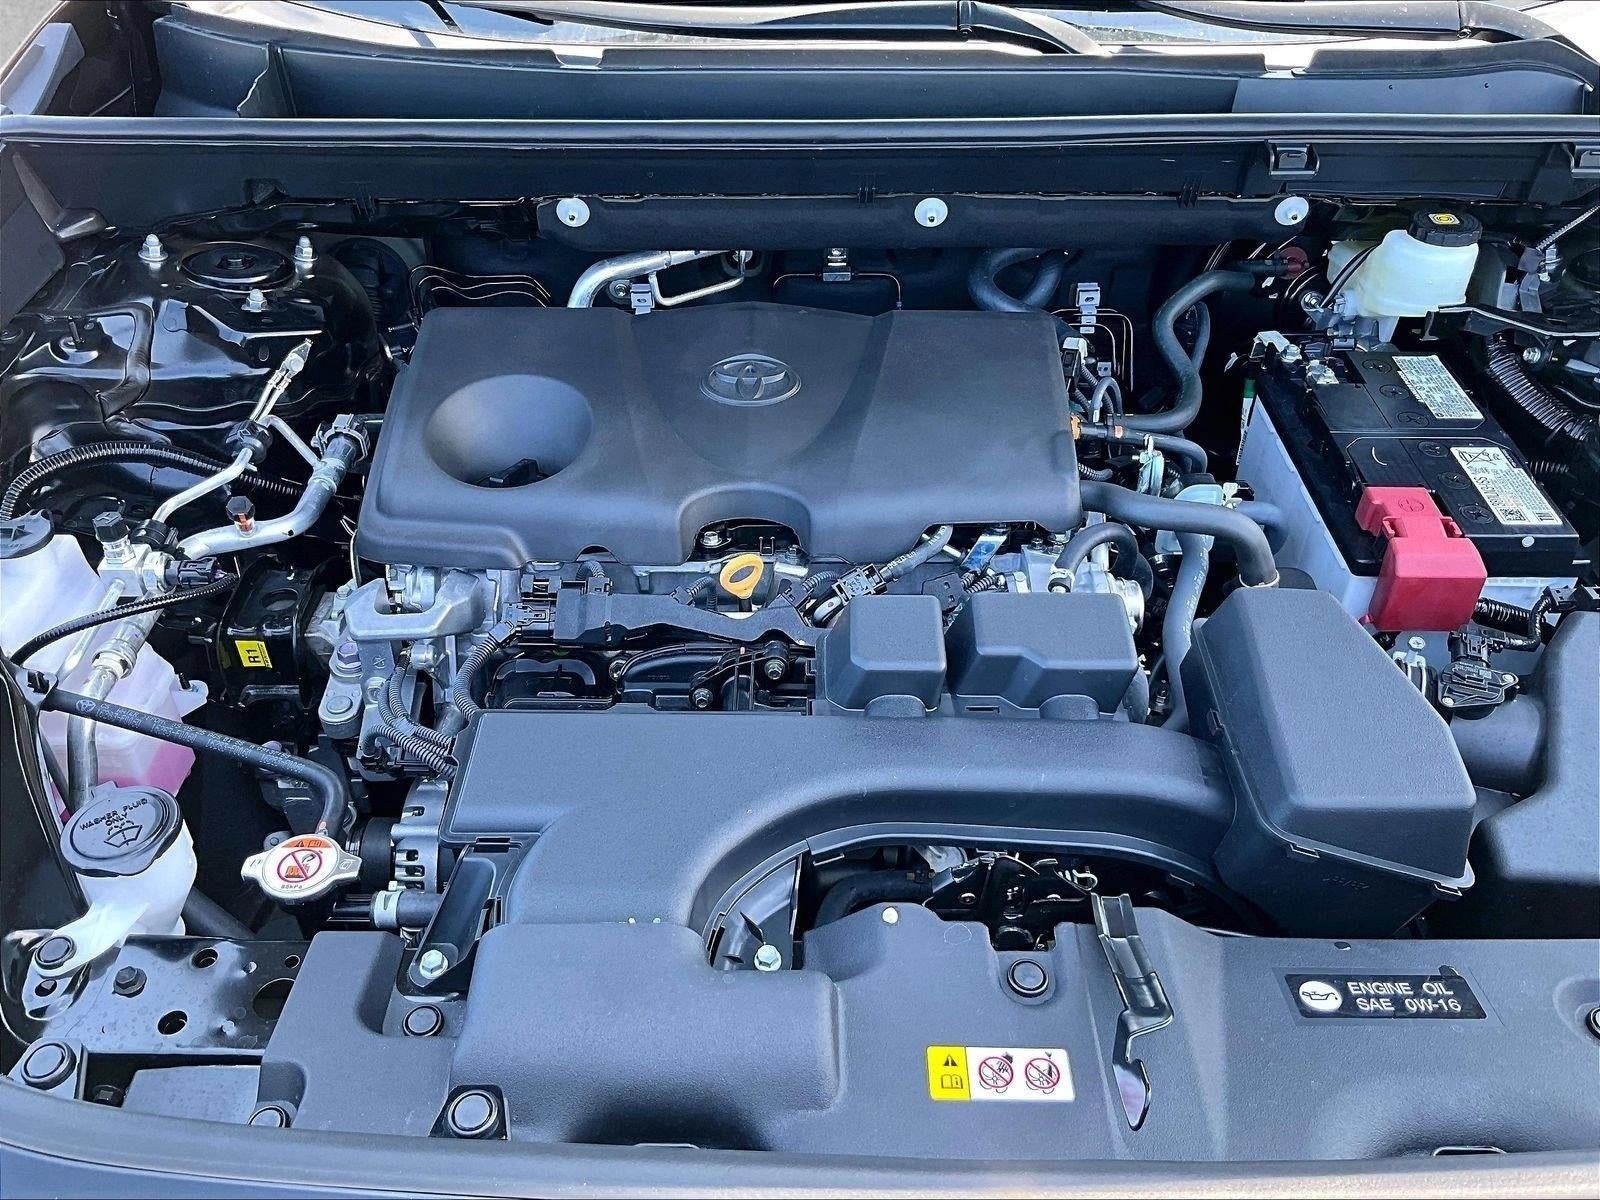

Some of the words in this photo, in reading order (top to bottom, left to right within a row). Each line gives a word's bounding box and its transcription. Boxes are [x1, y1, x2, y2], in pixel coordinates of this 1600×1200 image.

[246, 649, 262, 664] R1
[105, 812, 129, 827] ONLY
[1347, 981, 1414, 995] ENGINE
[1422, 981, 1454, 995] OIL
[1356, 998, 1395, 1012] SAE
[1404, 998, 1462, 1013] 0W-16
